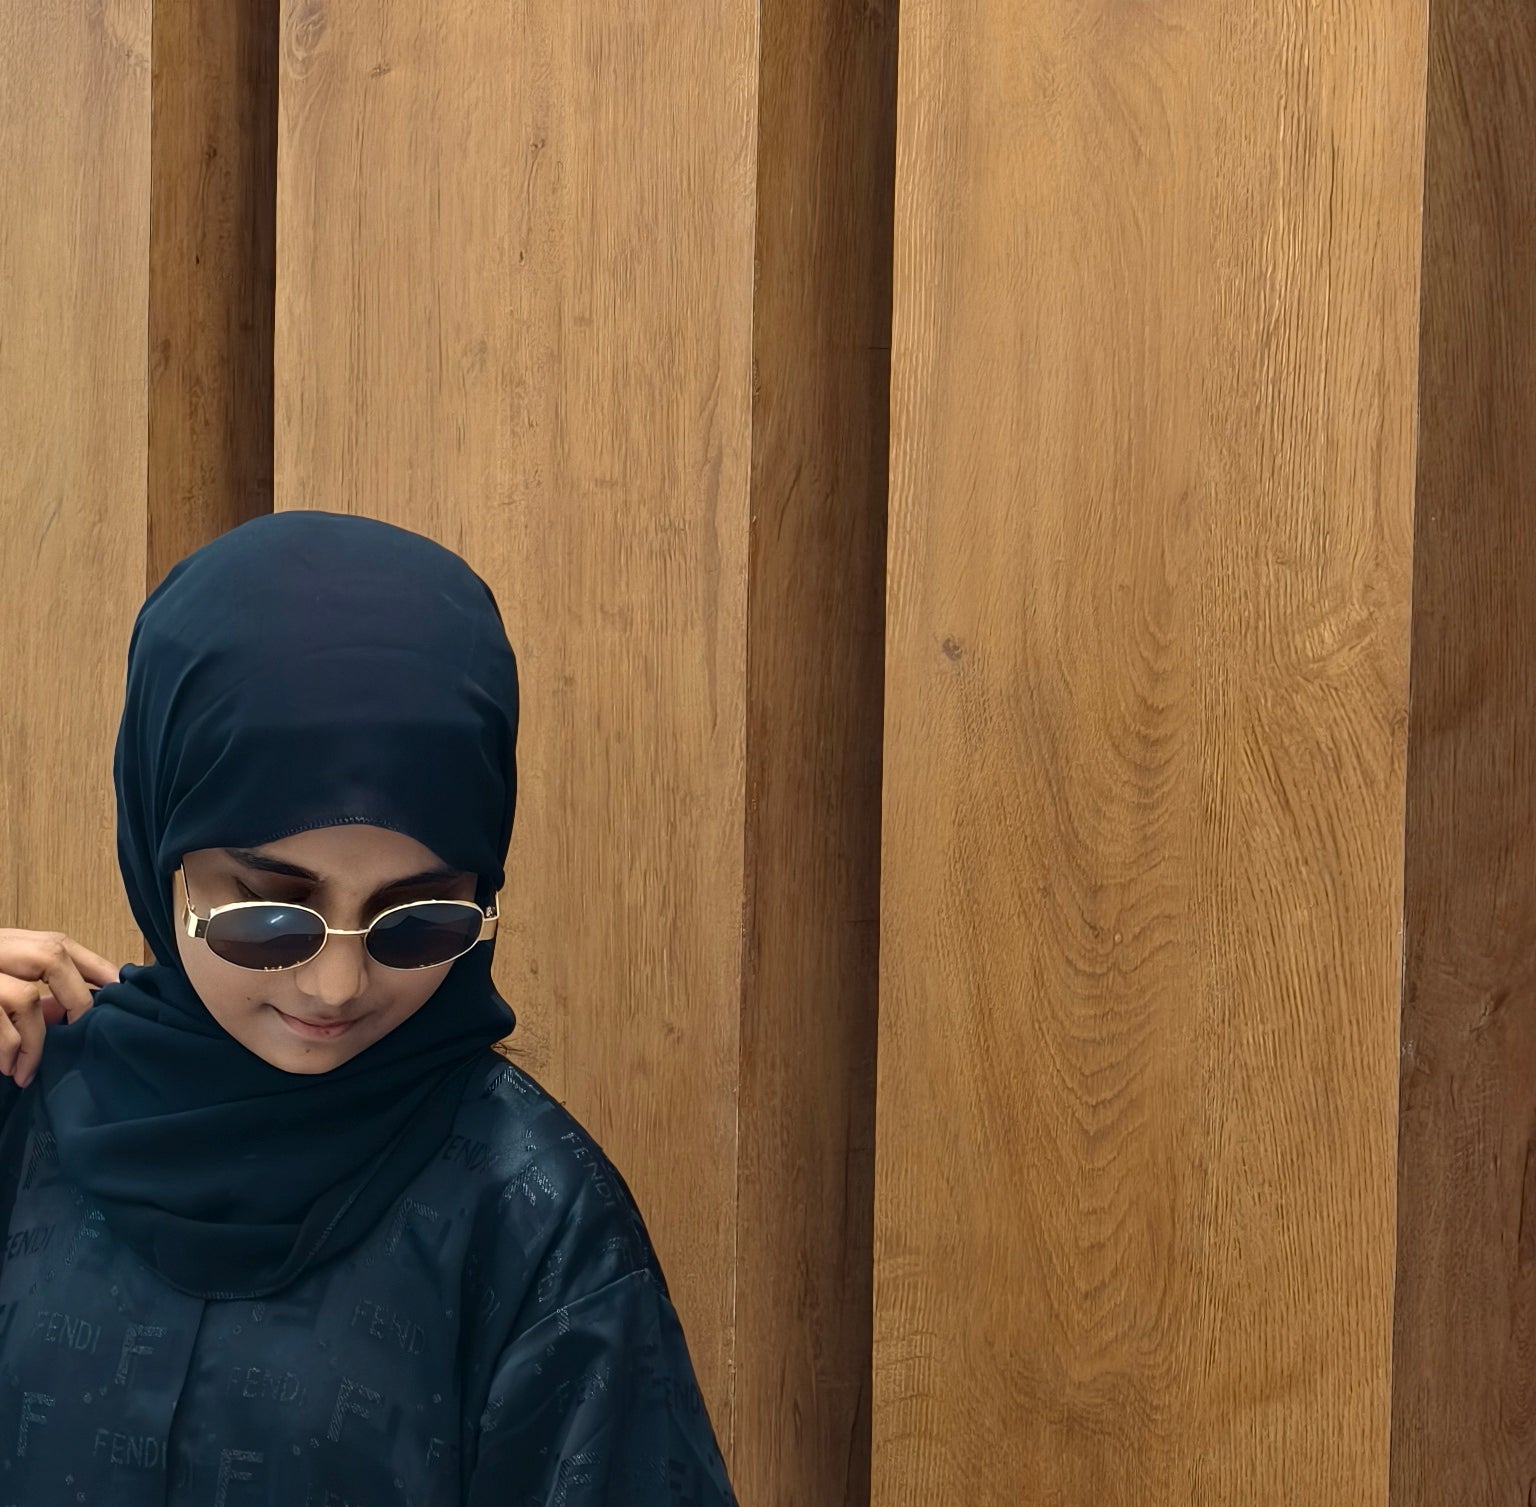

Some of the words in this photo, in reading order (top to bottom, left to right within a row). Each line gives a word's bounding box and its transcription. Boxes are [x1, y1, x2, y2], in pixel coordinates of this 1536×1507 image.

[65, 1206, 106, 1266] F
[31, 1310, 102, 1354] FENDI
[115, 1324, 167, 1385] F
[228, 1367, 306, 1406] FENDI
[327, 1376, 383, 1442] F
[16, 1391, 55, 1456] F
[94, 1428, 167, 1469] FENDI
